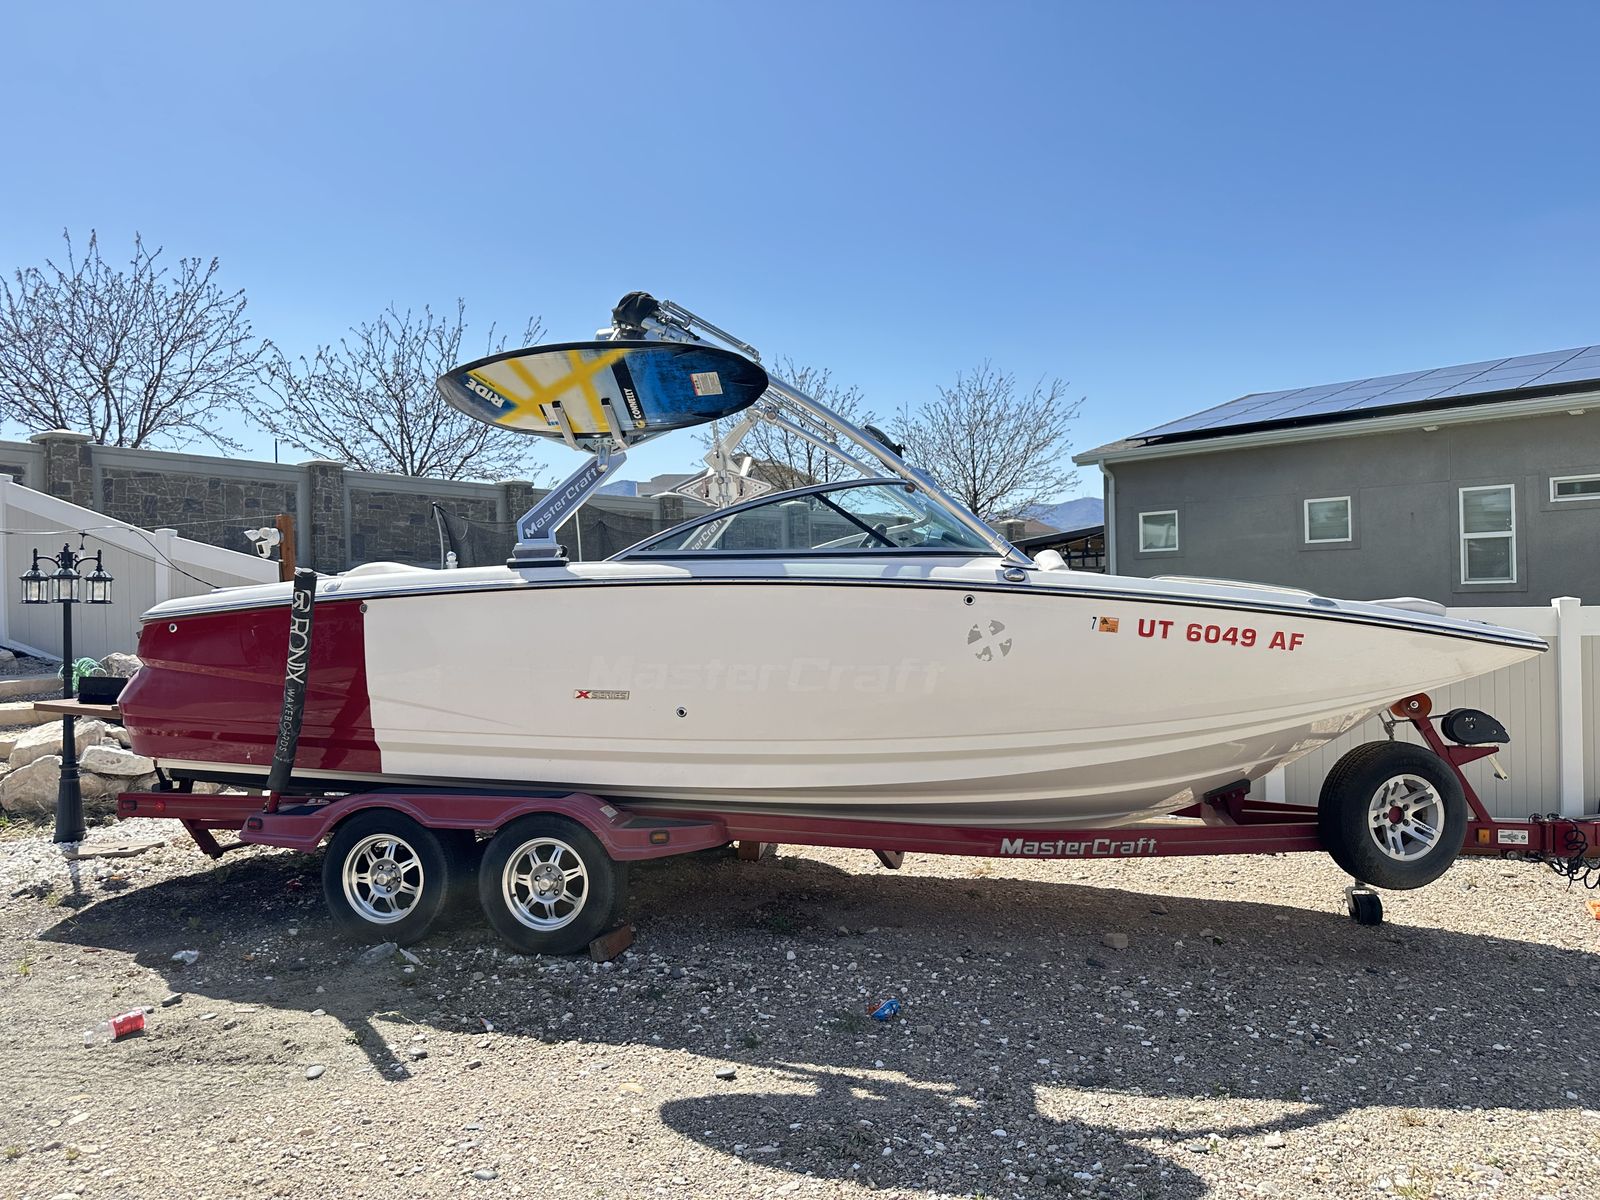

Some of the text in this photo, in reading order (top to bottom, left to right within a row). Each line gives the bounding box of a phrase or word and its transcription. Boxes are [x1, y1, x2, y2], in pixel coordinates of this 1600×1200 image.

[464, 378, 505, 409] RIDE
[622, 387, 643, 419] CONNELLY
[525, 467, 598, 538] MasterCraft
[285, 615, 310, 684] RONIX
[1138, 618, 1305, 651] UT 6049 AF
[586, 654, 941, 695] MasterCraft
[1000, 837, 1157, 855] MasterCraft
